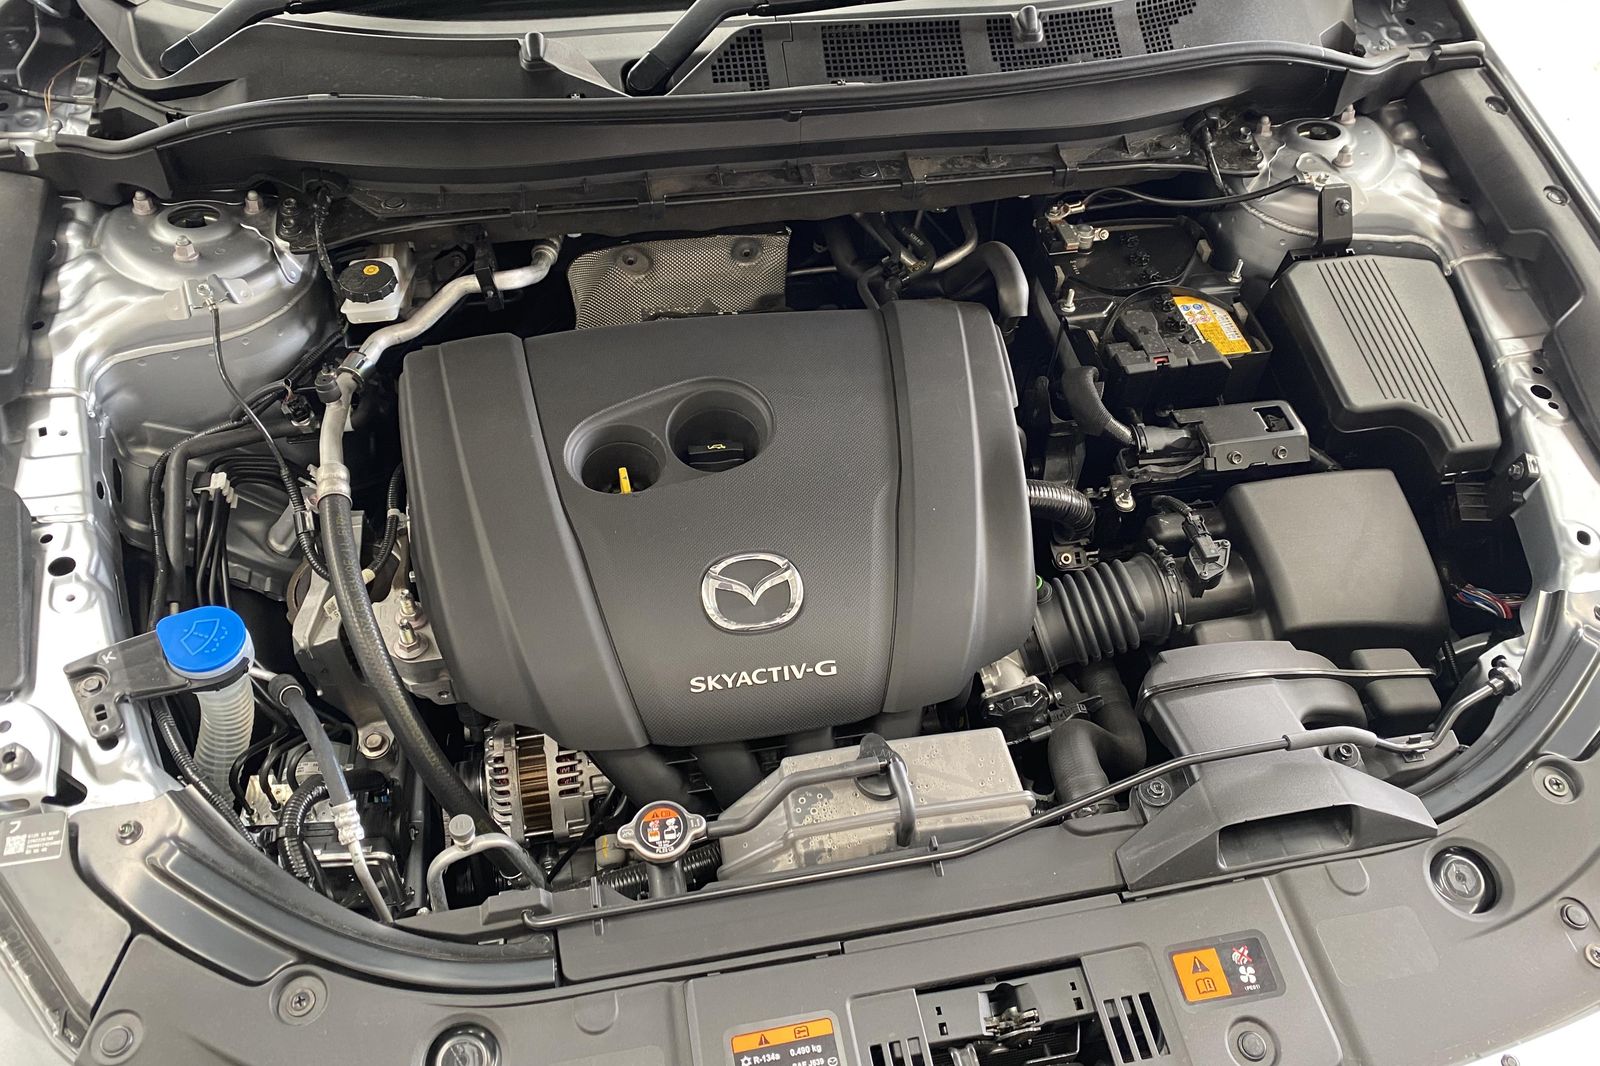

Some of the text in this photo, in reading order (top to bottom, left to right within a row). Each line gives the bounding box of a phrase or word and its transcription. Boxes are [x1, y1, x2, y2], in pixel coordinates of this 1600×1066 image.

[101, 651, 117, 664] K
[690, 660, 838, 693] SKYACTIV-G
[753, 1053, 780, 1065] R-134a
[811, 1044, 822, 1053] kg
